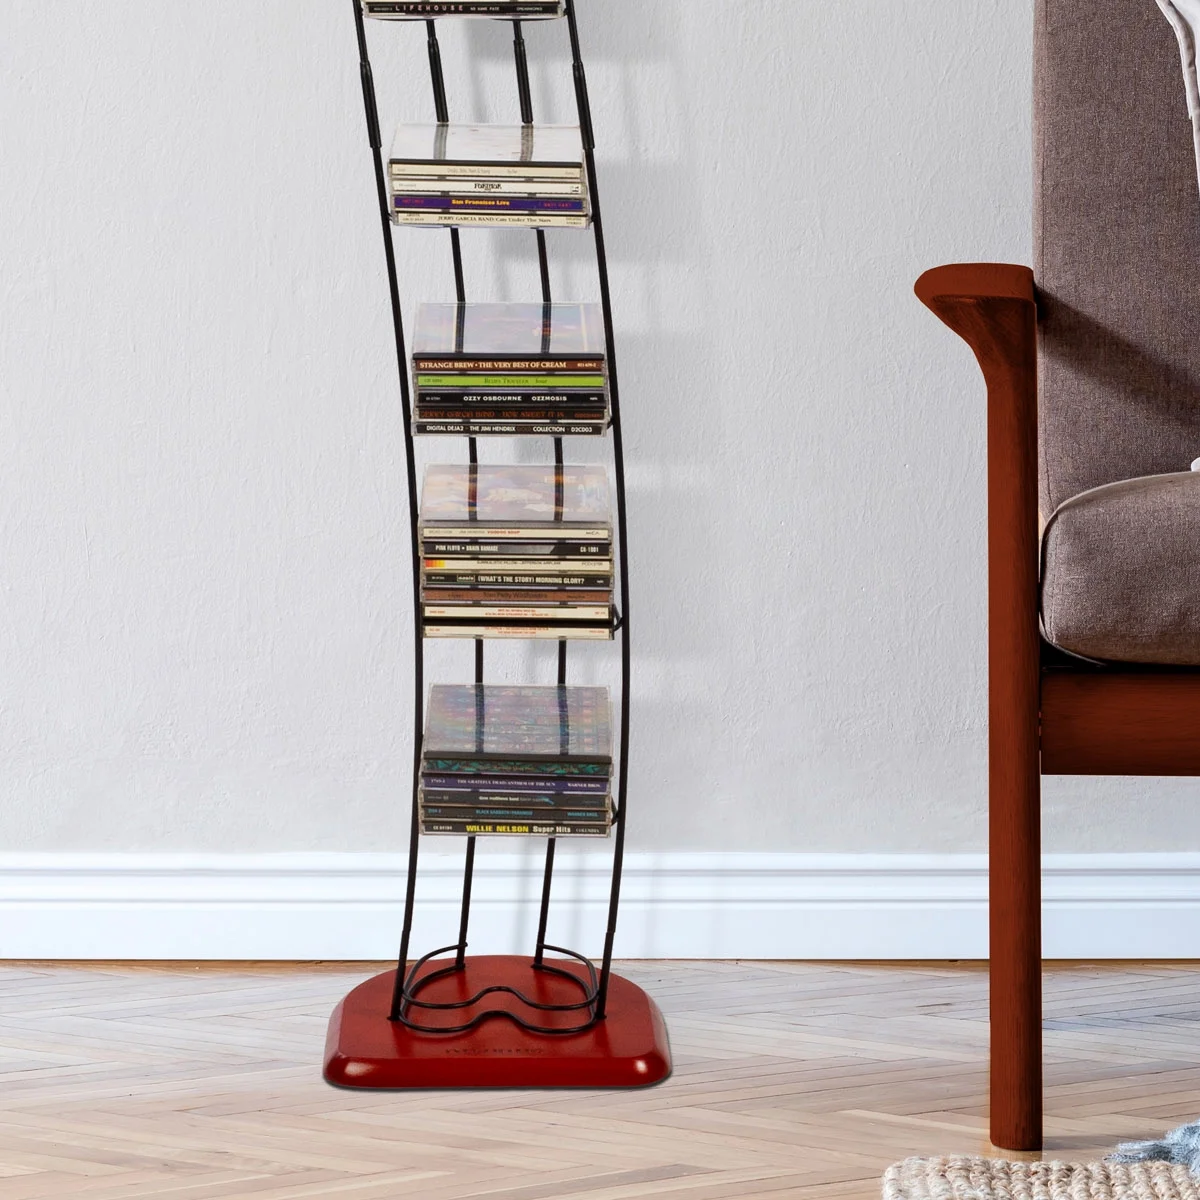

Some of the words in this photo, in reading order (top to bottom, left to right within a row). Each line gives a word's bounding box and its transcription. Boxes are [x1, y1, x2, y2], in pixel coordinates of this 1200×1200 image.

[419, 361, 454, 369] STRANGE
[454, 361, 474, 369] BREW
[478, 361, 491, 369] THE
[493, 361, 511, 369] VERY
[512, 361, 530, 369] BEST
[530, 361, 540, 369] OF
[540, 361, 567, 369] CREAM
[532, 425, 566, 433] COLLECTION
[435, 544, 447, 552] PINK
[447, 544, 461, 552] FLOYD
[477, 575, 502, 583] (WHAT'S
[514, 576, 535, 584] STORY)
[563, 577, 585, 585] GLORY?
[465, 824, 493, 832] WILLIE
[496, 825, 529, 833] NELSON
[532, 825, 555, 834] Super
[555, 825, 572, 833] Hits
